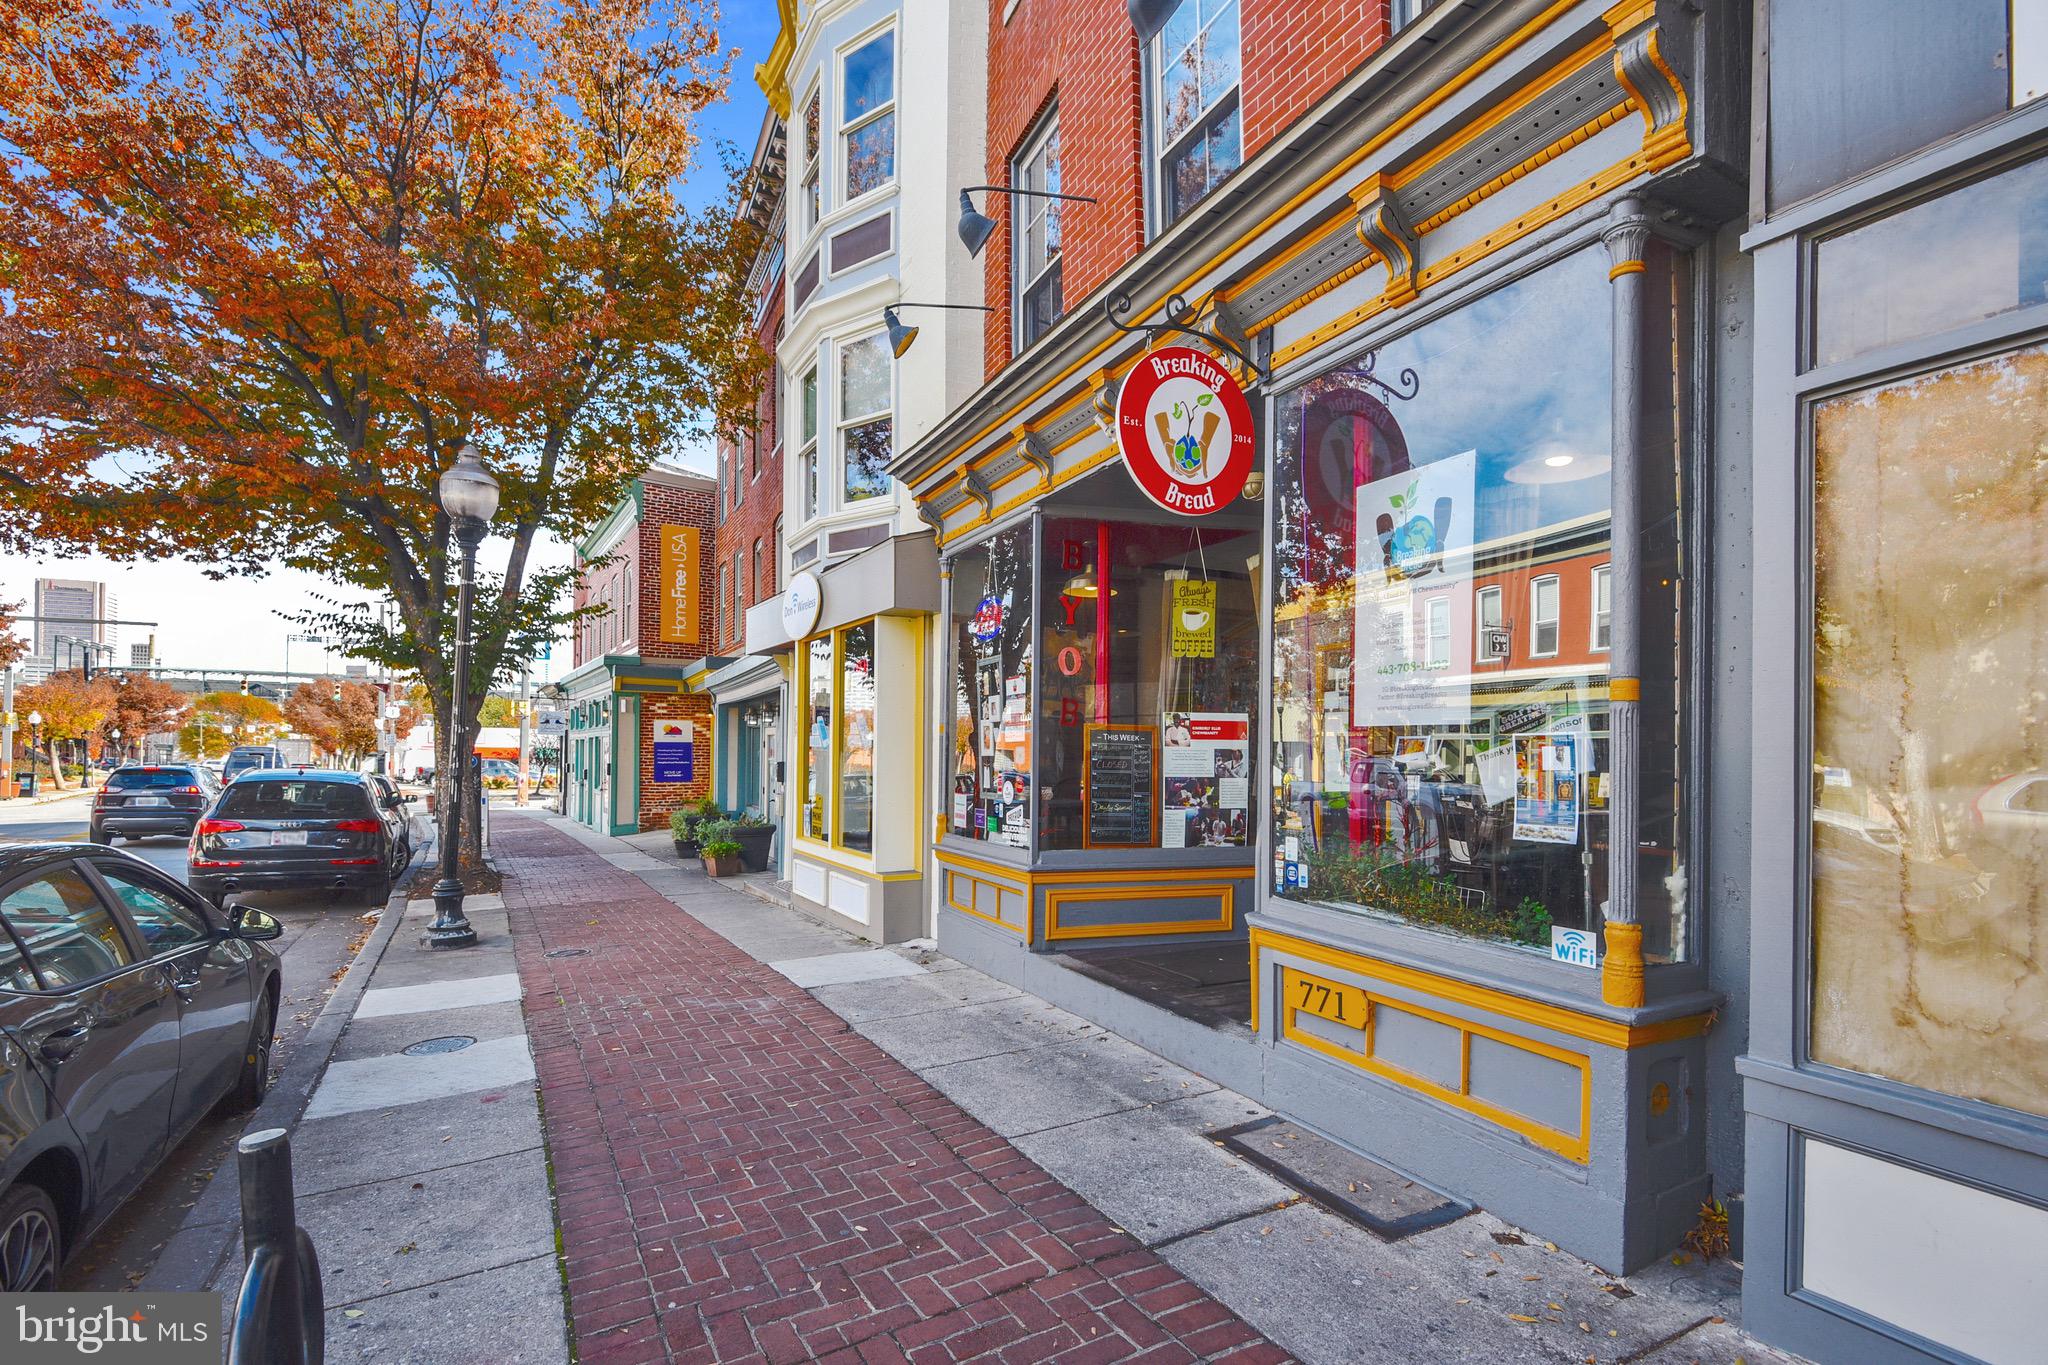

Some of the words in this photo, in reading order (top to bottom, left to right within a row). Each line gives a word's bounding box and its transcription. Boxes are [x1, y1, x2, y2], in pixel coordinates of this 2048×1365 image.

[1150, 354, 1226, 394] Breaking
[1123, 415, 1143, 428] Est.
[1234, 434, 1252, 445] 2014
[1165, 482, 1215, 510] Bread
[671, 533, 688, 562] USA
[1396, 546, 1431, 563] Breaking
[1180, 586, 1211, 599] Always
[797, 597, 816, 612] Wireless
[1173, 598, 1215, 608] FRESH
[1175, 627, 1211, 638] brewed
[1173, 640, 1213, 652] COFFEE
[1501, 708, 1525, 724] GOLF
[1478, 748, 1504, 762] Thank
[1096, 760, 1128, 769] CLOSED
[1555, 942, 1594, 966] WiFi
[1299, 980, 1347, 1021] 771
